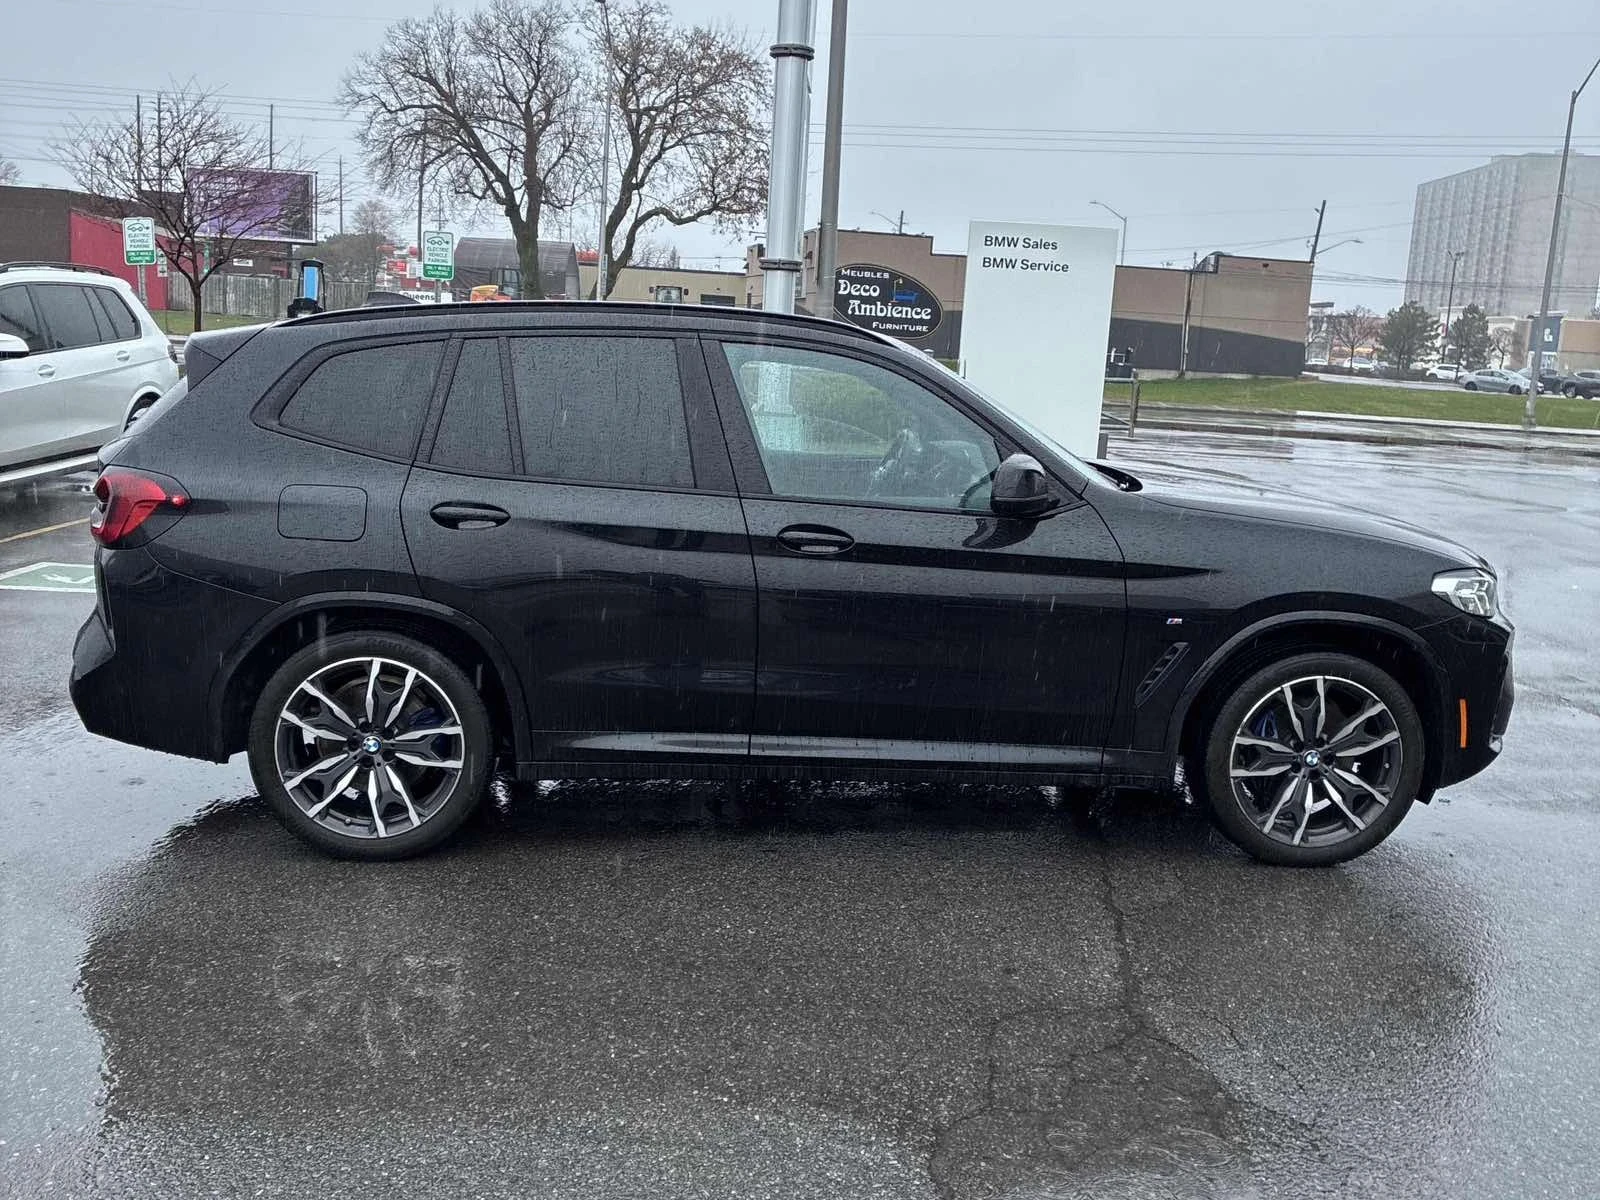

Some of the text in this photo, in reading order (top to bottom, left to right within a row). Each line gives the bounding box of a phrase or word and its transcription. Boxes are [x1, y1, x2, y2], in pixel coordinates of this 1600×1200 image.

[984, 235, 1058, 250] BMW Sales
[982, 257, 1069, 272] BMW Service
[841, 268, 890, 279] MEUBLES
[838, 280, 880, 297] Deco
[847, 299, 932, 320] Ambience
[872, 321, 929, 332] FURNITURE
